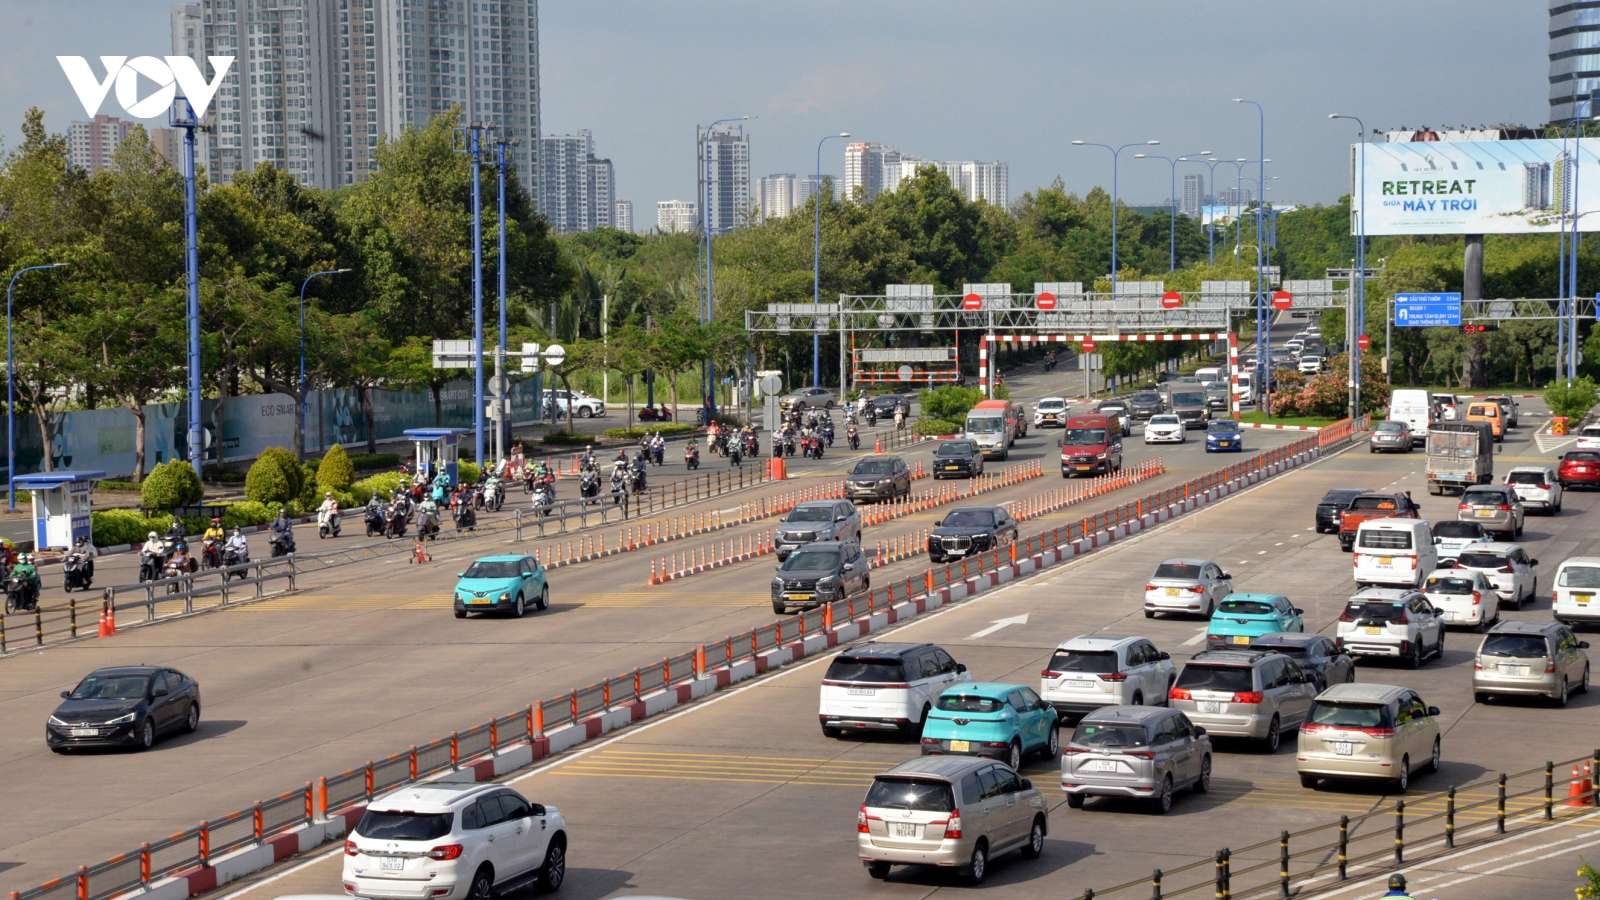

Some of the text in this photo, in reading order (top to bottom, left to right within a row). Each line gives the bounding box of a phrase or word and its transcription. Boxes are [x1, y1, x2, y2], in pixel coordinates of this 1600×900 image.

[1382, 179, 1476, 195] RETREAT
[1383, 197, 1477, 211] GIỮA MÂY TRỜI
[1464, 326, 1476, 334] 53
[440, 390, 457, 402] SMART
[458, 389, 469, 400] CITY
[261, 405, 275, 416] ECO
